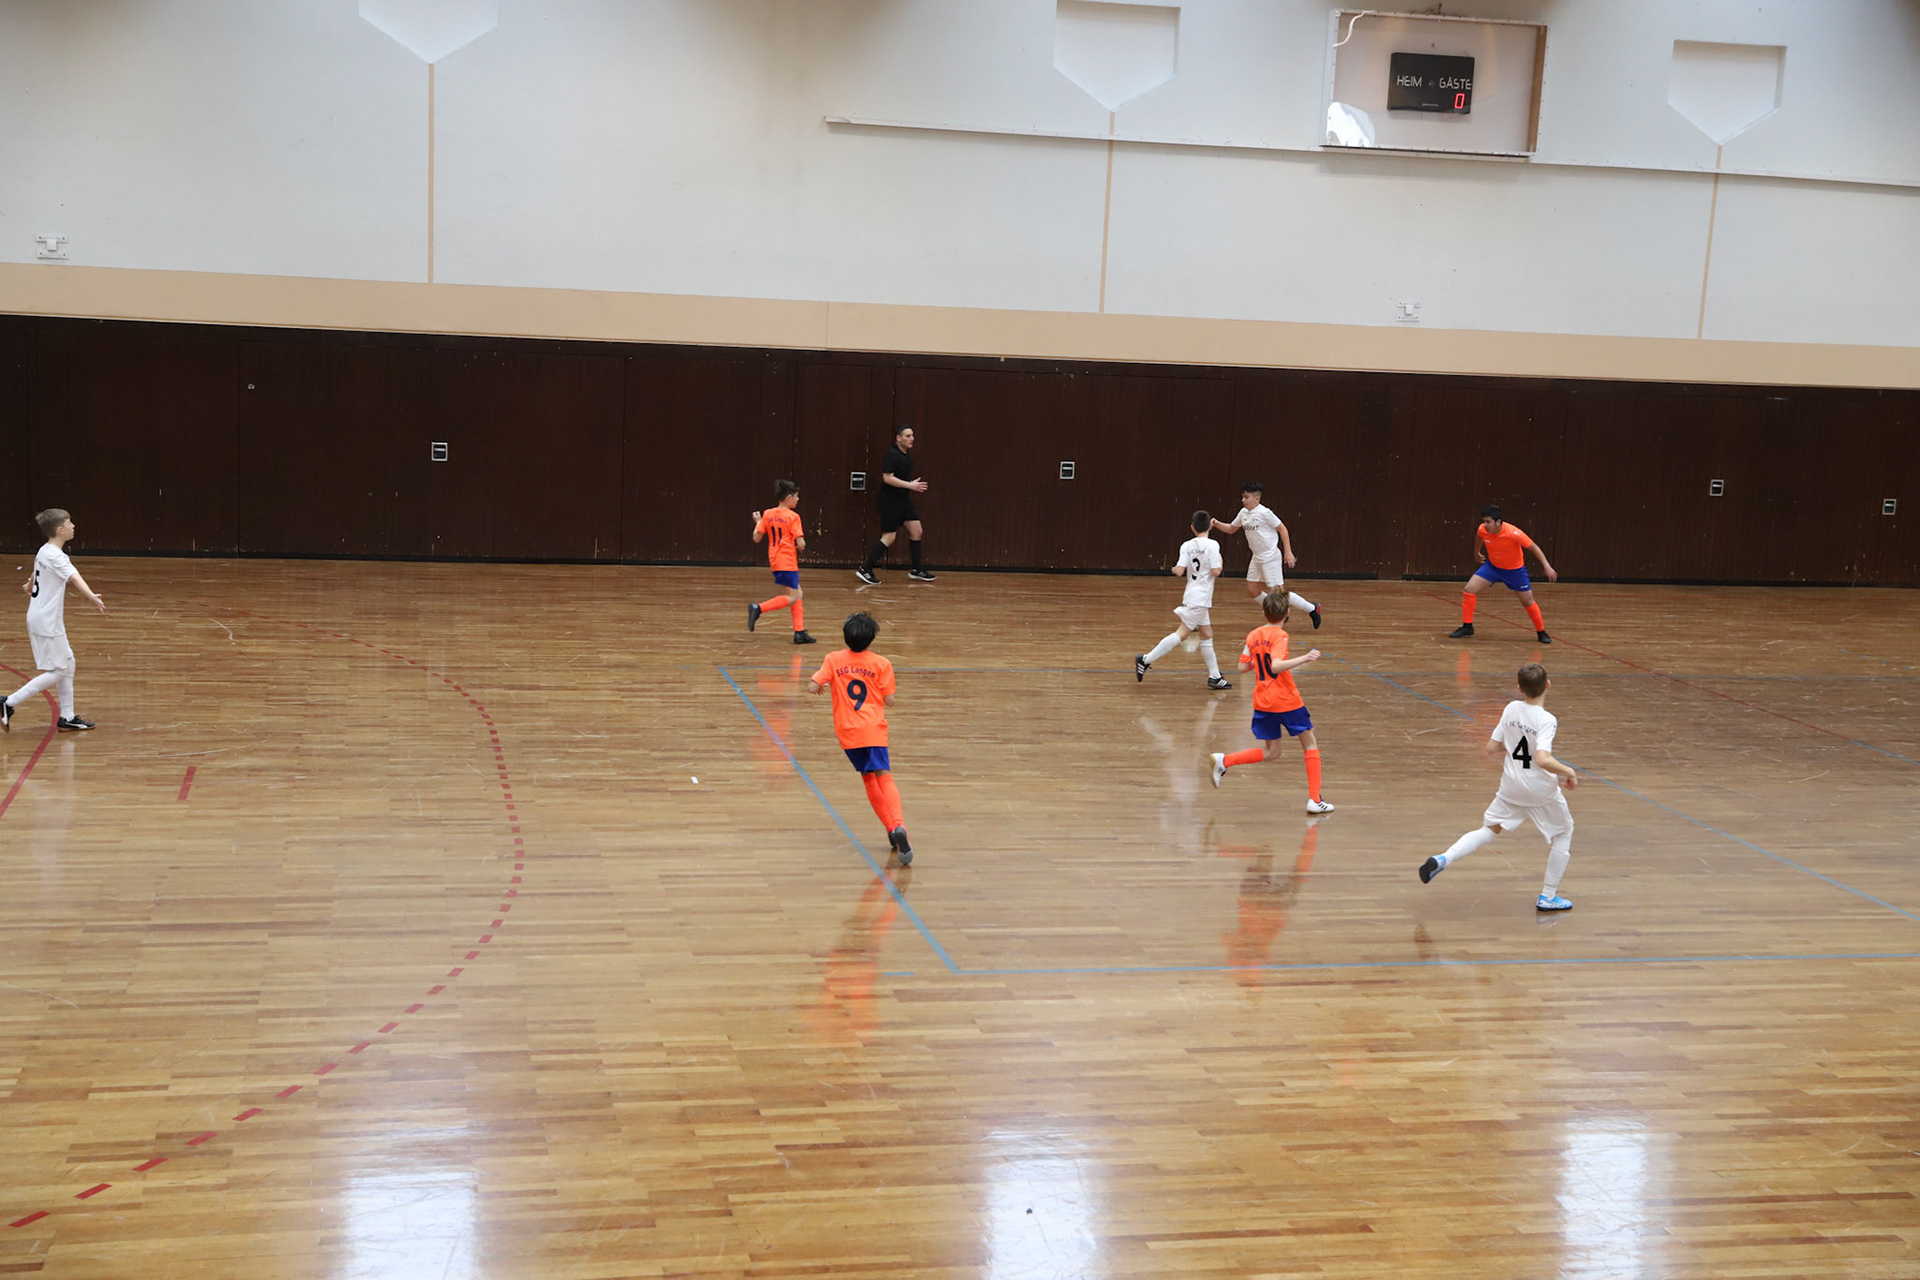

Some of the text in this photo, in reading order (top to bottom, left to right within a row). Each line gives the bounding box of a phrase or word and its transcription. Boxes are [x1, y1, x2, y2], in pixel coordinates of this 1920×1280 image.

[1396, 75, 1472, 90] HEIM GÄSTE
[1454, 92, 1466, 109] 0
[770, 525, 783, 547] 11
[1191, 557, 1201, 580] 3
[836, 666, 876, 678] SSG Langen
[1255, 652, 1279, 681] 10
[847, 679, 868, 711] 9
[1512, 735, 1533, 769] 4
